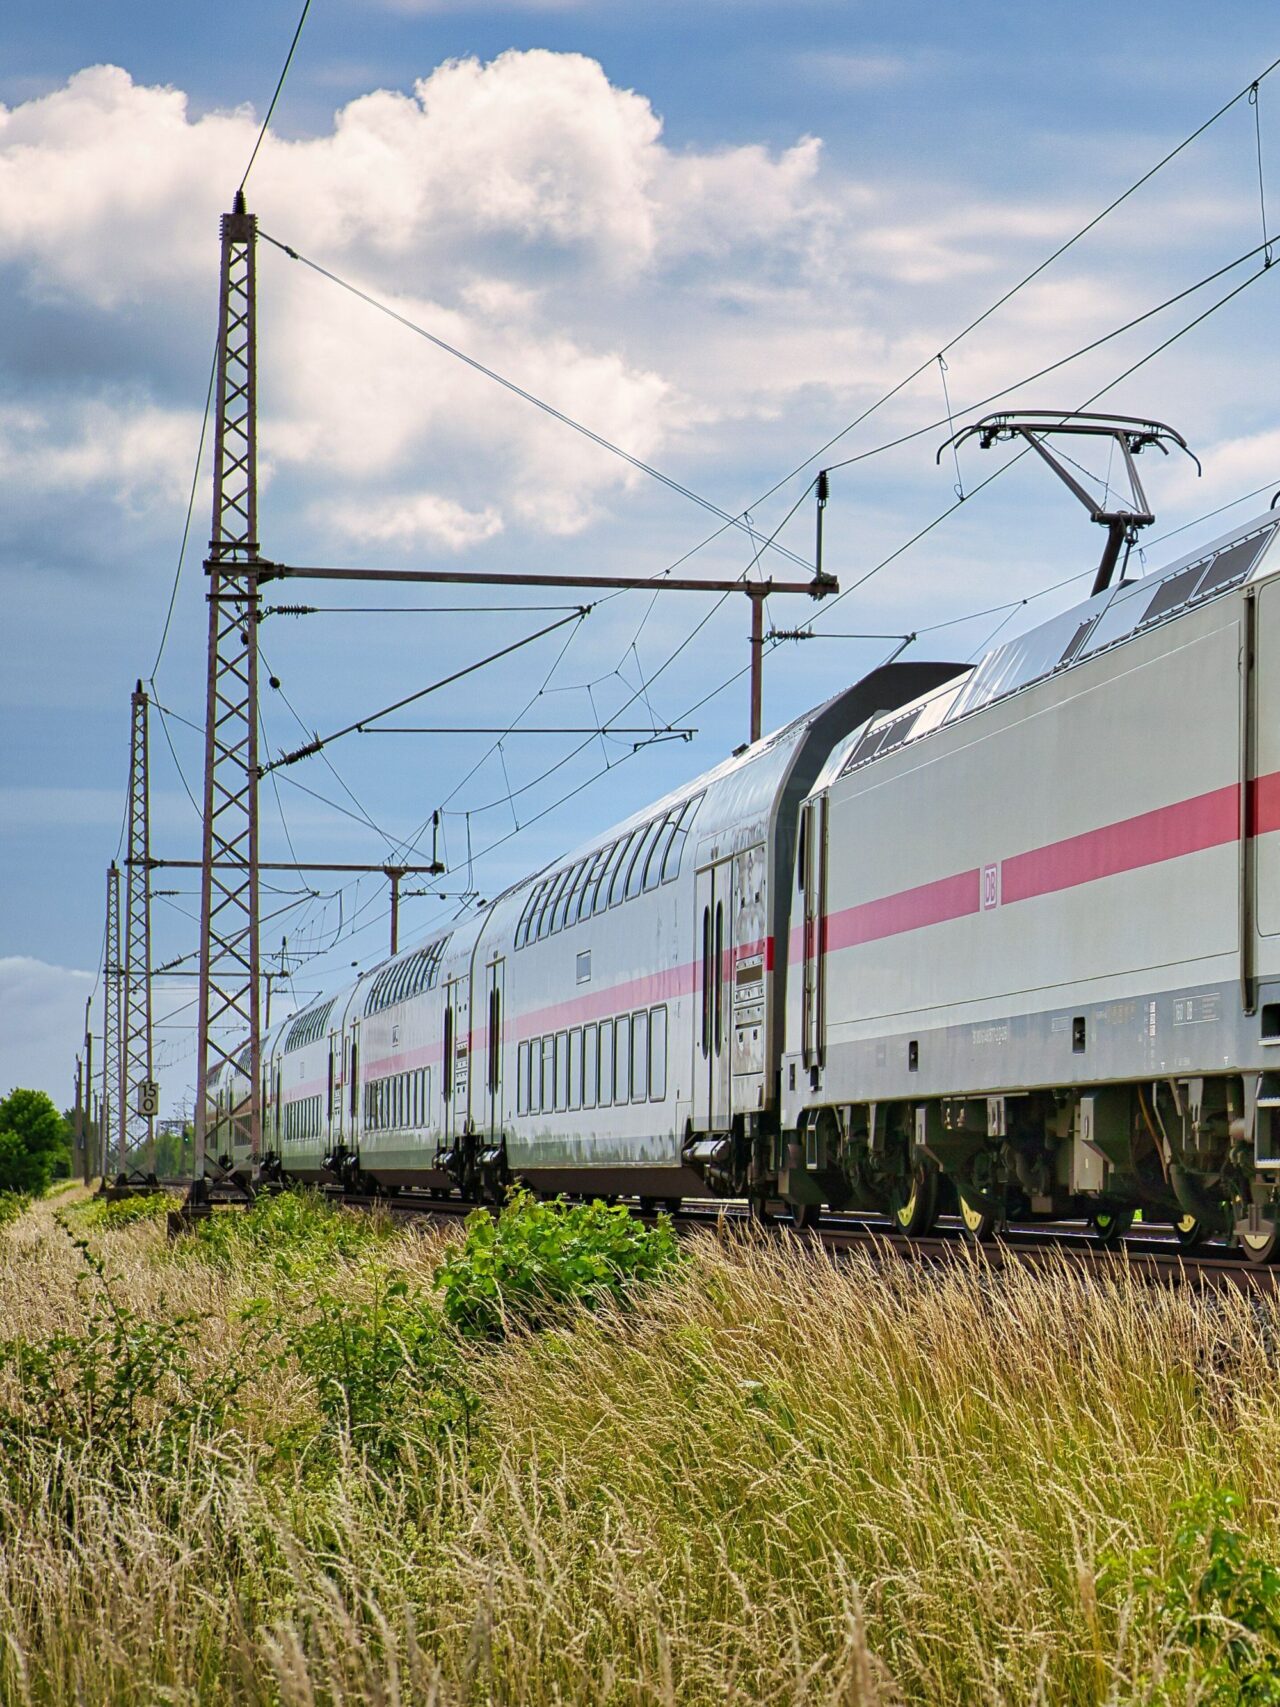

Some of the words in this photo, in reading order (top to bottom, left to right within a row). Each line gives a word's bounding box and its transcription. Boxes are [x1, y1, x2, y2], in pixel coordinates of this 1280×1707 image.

[985, 869, 996, 905] DB
[142, 1084, 157, 1098] 15
[143, 1098, 154, 1112] 0
